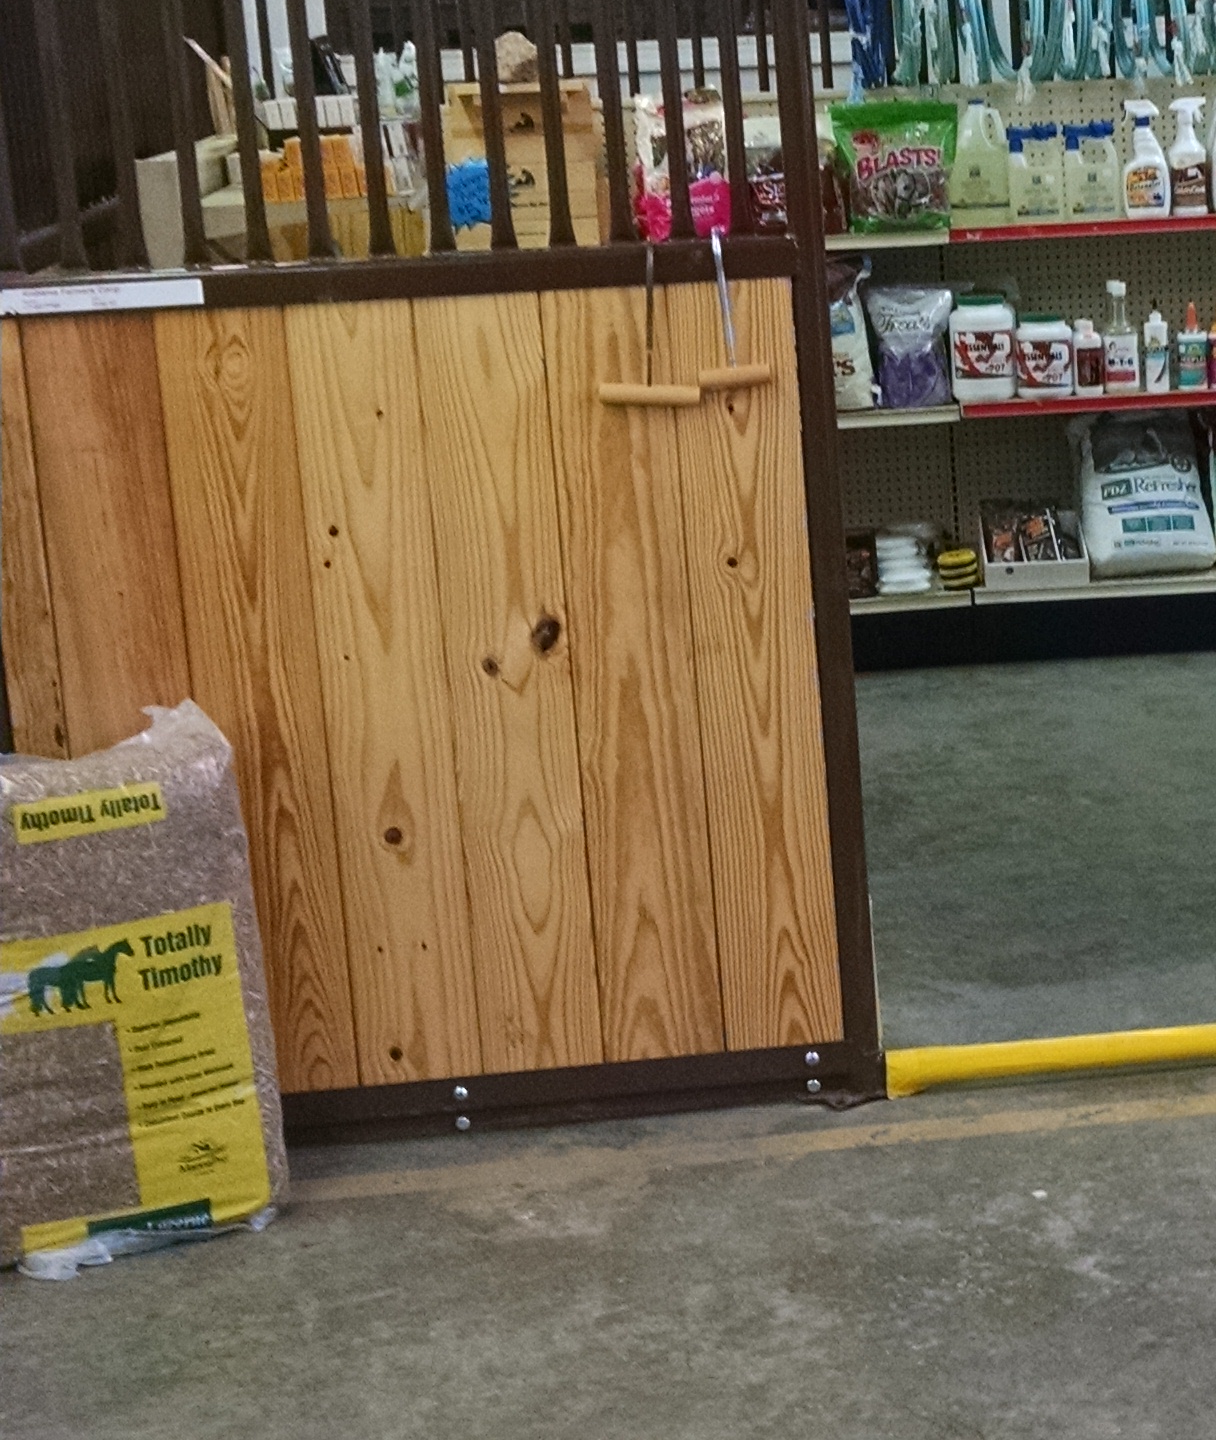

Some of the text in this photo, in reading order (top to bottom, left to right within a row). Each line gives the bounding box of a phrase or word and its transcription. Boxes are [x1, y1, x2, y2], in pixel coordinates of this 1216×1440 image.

[20, 792, 162, 832] Totally Timothy
[139, 922, 212, 958] Totally
[138, 953, 223, 991] Timothy
